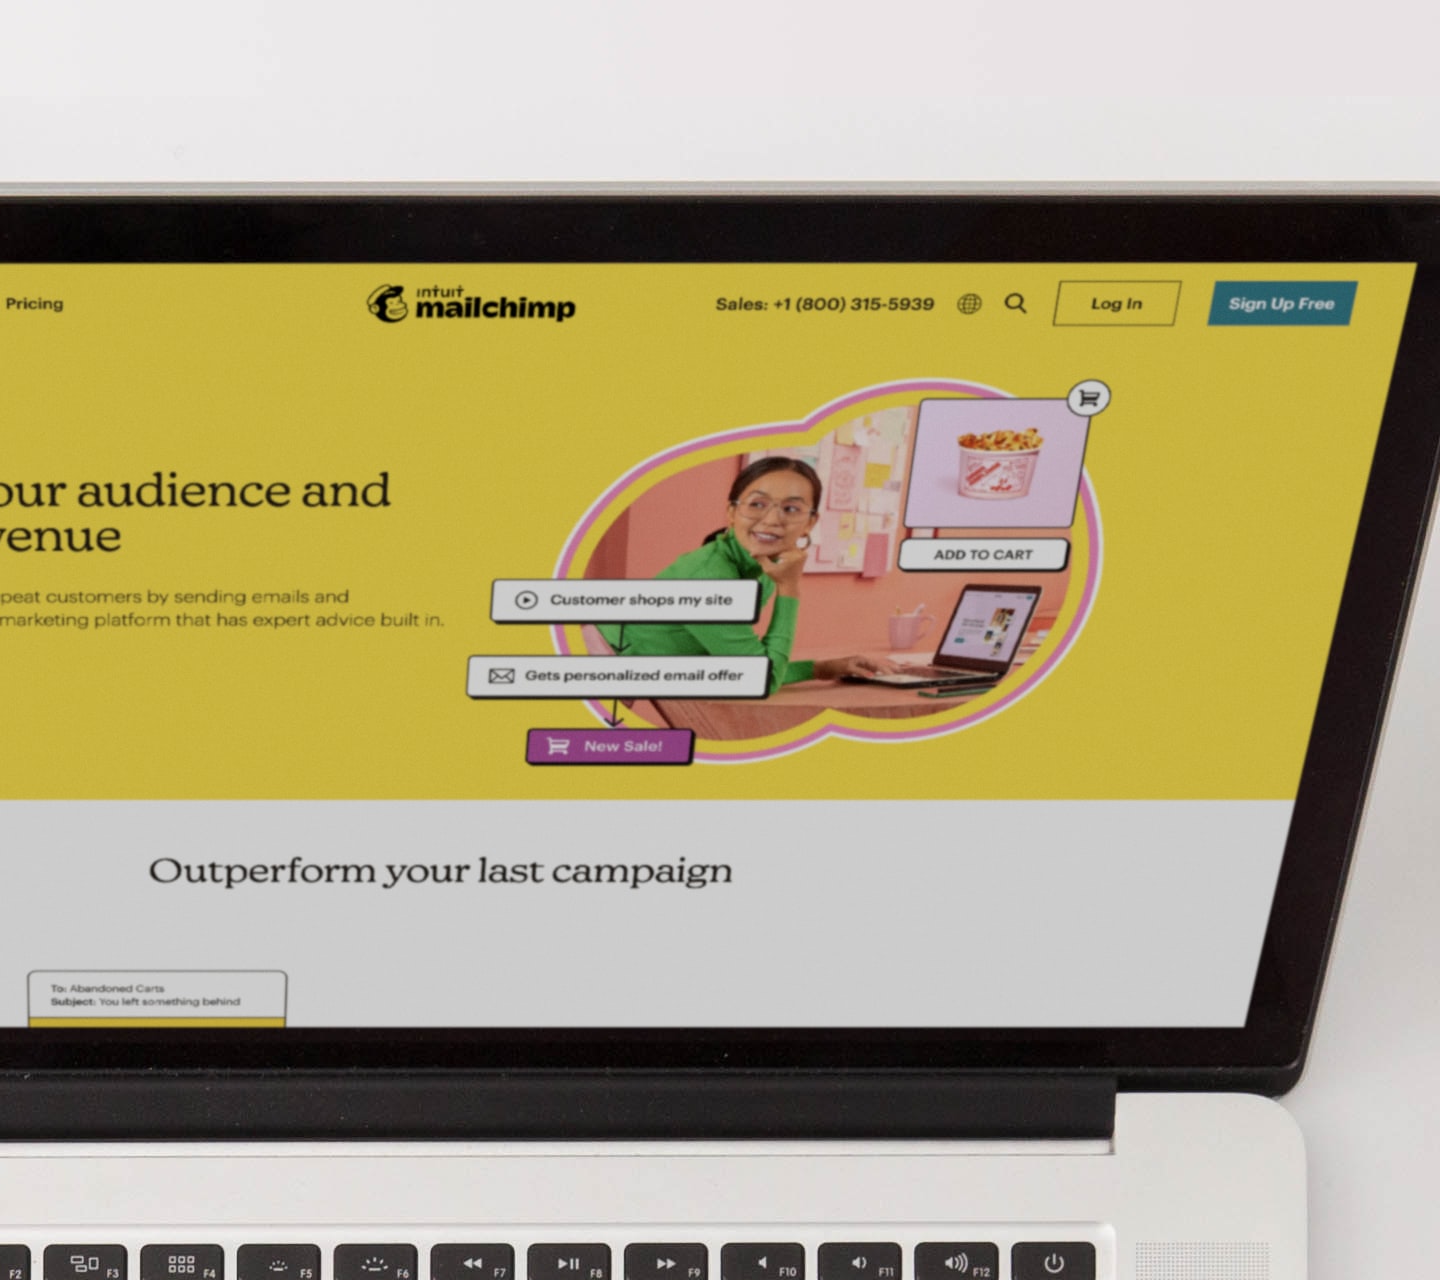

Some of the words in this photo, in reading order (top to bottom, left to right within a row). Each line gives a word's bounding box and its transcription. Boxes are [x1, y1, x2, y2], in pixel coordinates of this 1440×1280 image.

[416, 284, 466, 298] intuit
[5, 296, 64, 313] Pricing
[415, 295, 576, 323] mailchimp
[715, 296, 769, 312] Sales:
[773, 297, 791, 311] +1
[795, 296, 847, 314] (800)
[849, 296, 936, 312] 315-5939
[1090, 297, 1123, 313] Log
[1126, 297, 1143, 310] In
[1228, 296, 1268, 314] Sign
[1270, 296, 1296, 313] Up
[1297, 296, 1336, 311] Free
[77, 471, 291, 508] audience
[301, 471, 392, 508] and
[933, 549, 967, 561] ADD
[969, 549, 991, 561] TO
[992, 549, 1034, 561] CART
[45, 591, 143, 604] customers
[146, 589, 169, 606] by
[173, 588, 247, 607] sending
[251, 589, 310, 604] emails
[314, 588, 350, 604] and
[549, 593, 626, 606] Customer
[628, 593, 676, 608] shops
[677, 596, 703, 608] my
[704, 594, 734, 606] site
[94, 611, 172, 630] platform
[175, 612, 211, 627] that
[216, 612, 249, 628] has
[252, 614, 311, 630] expert
[315, 612, 376, 628] advice
[380, 611, 420, 628] built
[424, 612, 445, 628] in.
[524, 669, 561, 682] Gets
[563, 669, 661, 684] personalized
[663, 669, 706, 682] email
[707, 669, 744, 682] offer
[584, 740, 621, 753] New
[623, 739, 663, 753] Sale!
[149, 856, 376, 890] Outperform
[381, 863, 471, 890] your
[478, 856, 545, 884] last
[551, 861, 732, 890] campaign
[50, 983, 67, 994] To:
[69, 983, 134, 994] Abandoned
[135, 983, 165, 994] Carts
[50, 997, 96, 1008] Subject:
[98, 997, 120, 1007] You
[121, 997, 140, 1007] left
[141, 997, 201, 1008] something
[202, 997, 241, 1007] behind
[9, 1268, 22, 1280] F2
[106, 1268, 120, 1279] F3
[203, 1268, 216, 1279] F4
[299, 1268, 313, 1279] F5
[396, 1268, 410, 1280] F6
[493, 1267, 507, 1278] F7
[590, 1267, 603, 1279] F8
[687, 1267, 701, 1279] F9
[779, 1266, 797, 1278] F10
[878, 1266, 894, 1278] F11
[972, 1266, 991, 1278] F12
